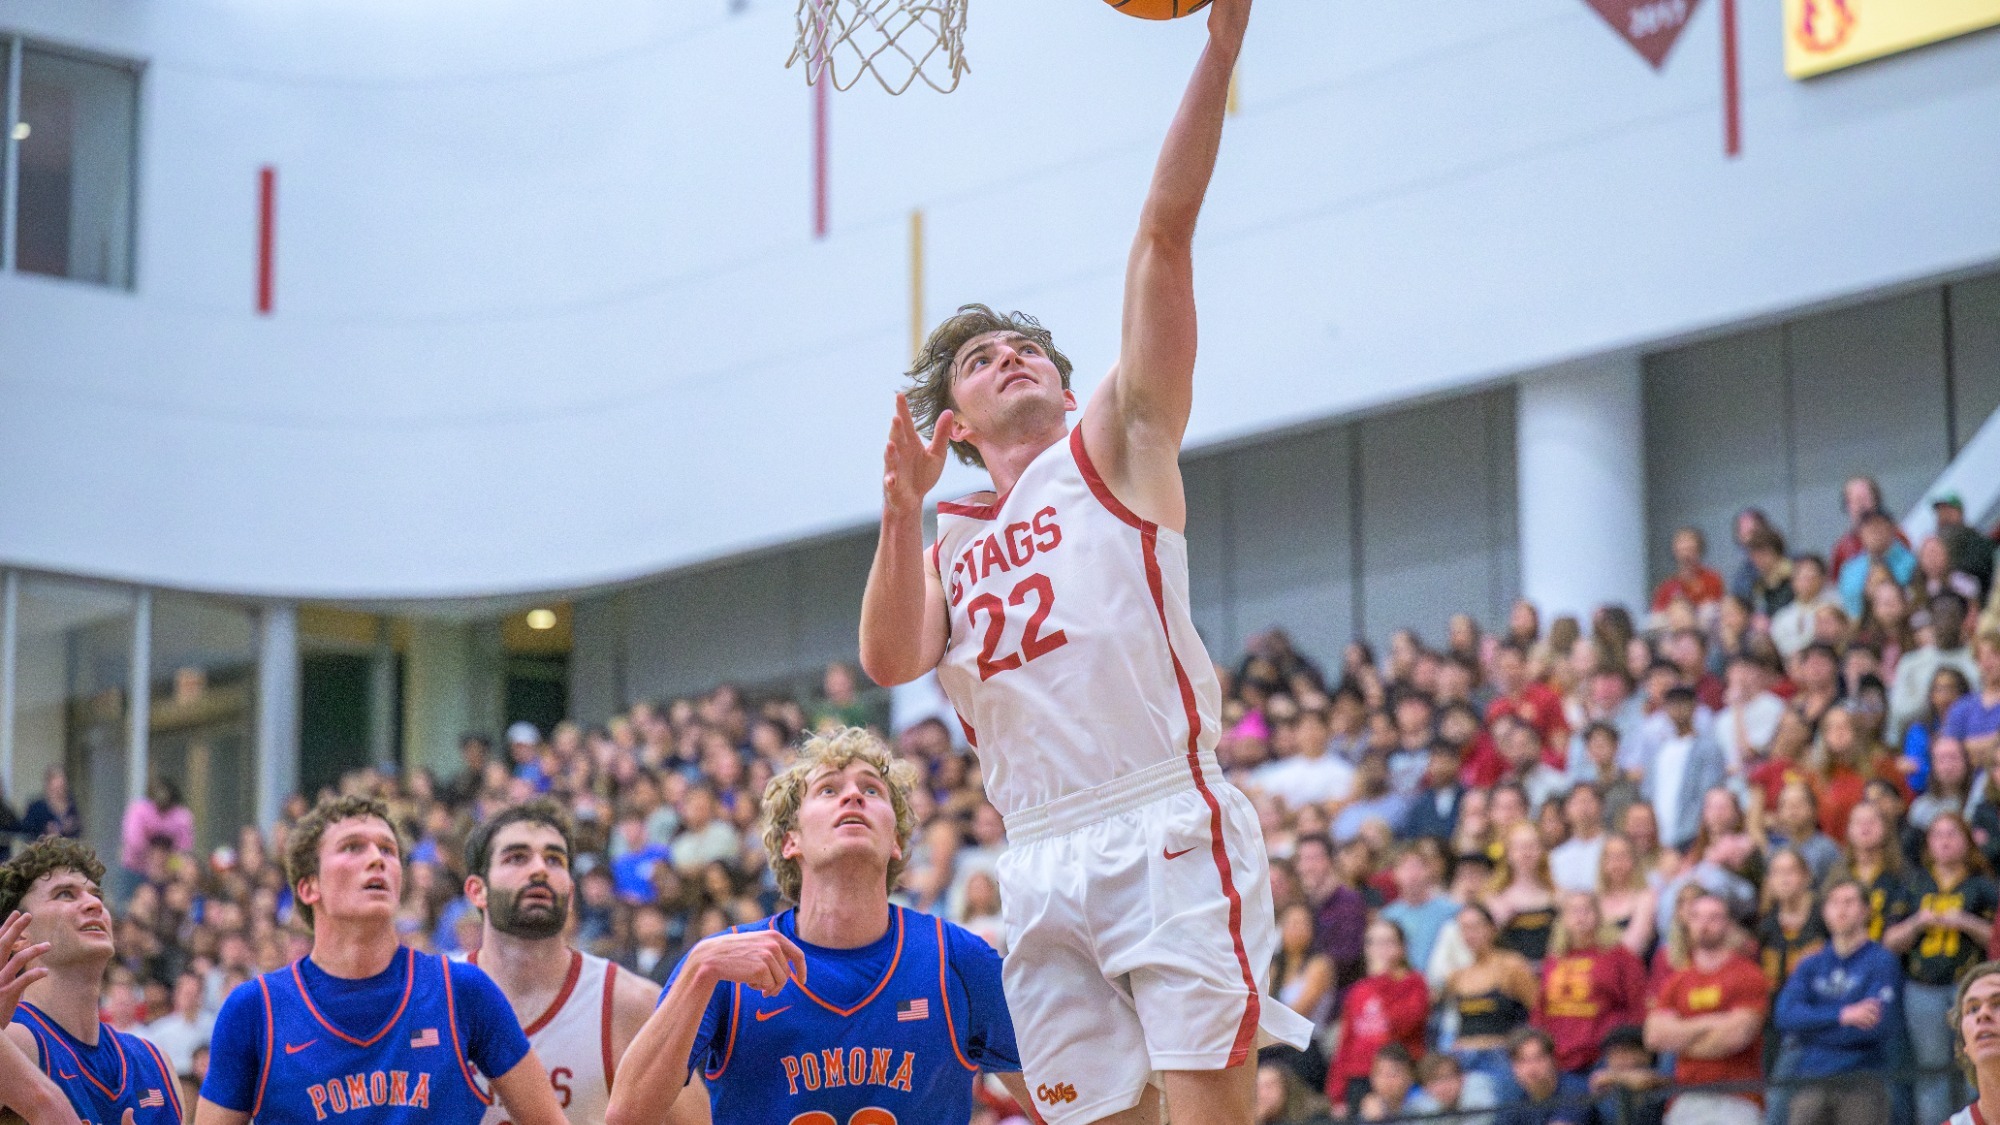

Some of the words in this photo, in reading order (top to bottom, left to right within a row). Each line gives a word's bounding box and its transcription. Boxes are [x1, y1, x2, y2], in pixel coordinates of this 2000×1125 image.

[952, 506, 1062, 607] STAGS
[967, 573, 1068, 682] 22
[306, 1070, 430, 1121] POMONA
[780, 1047, 915, 1095] POMONA
[1037, 1082, 1078, 1106] CMS
